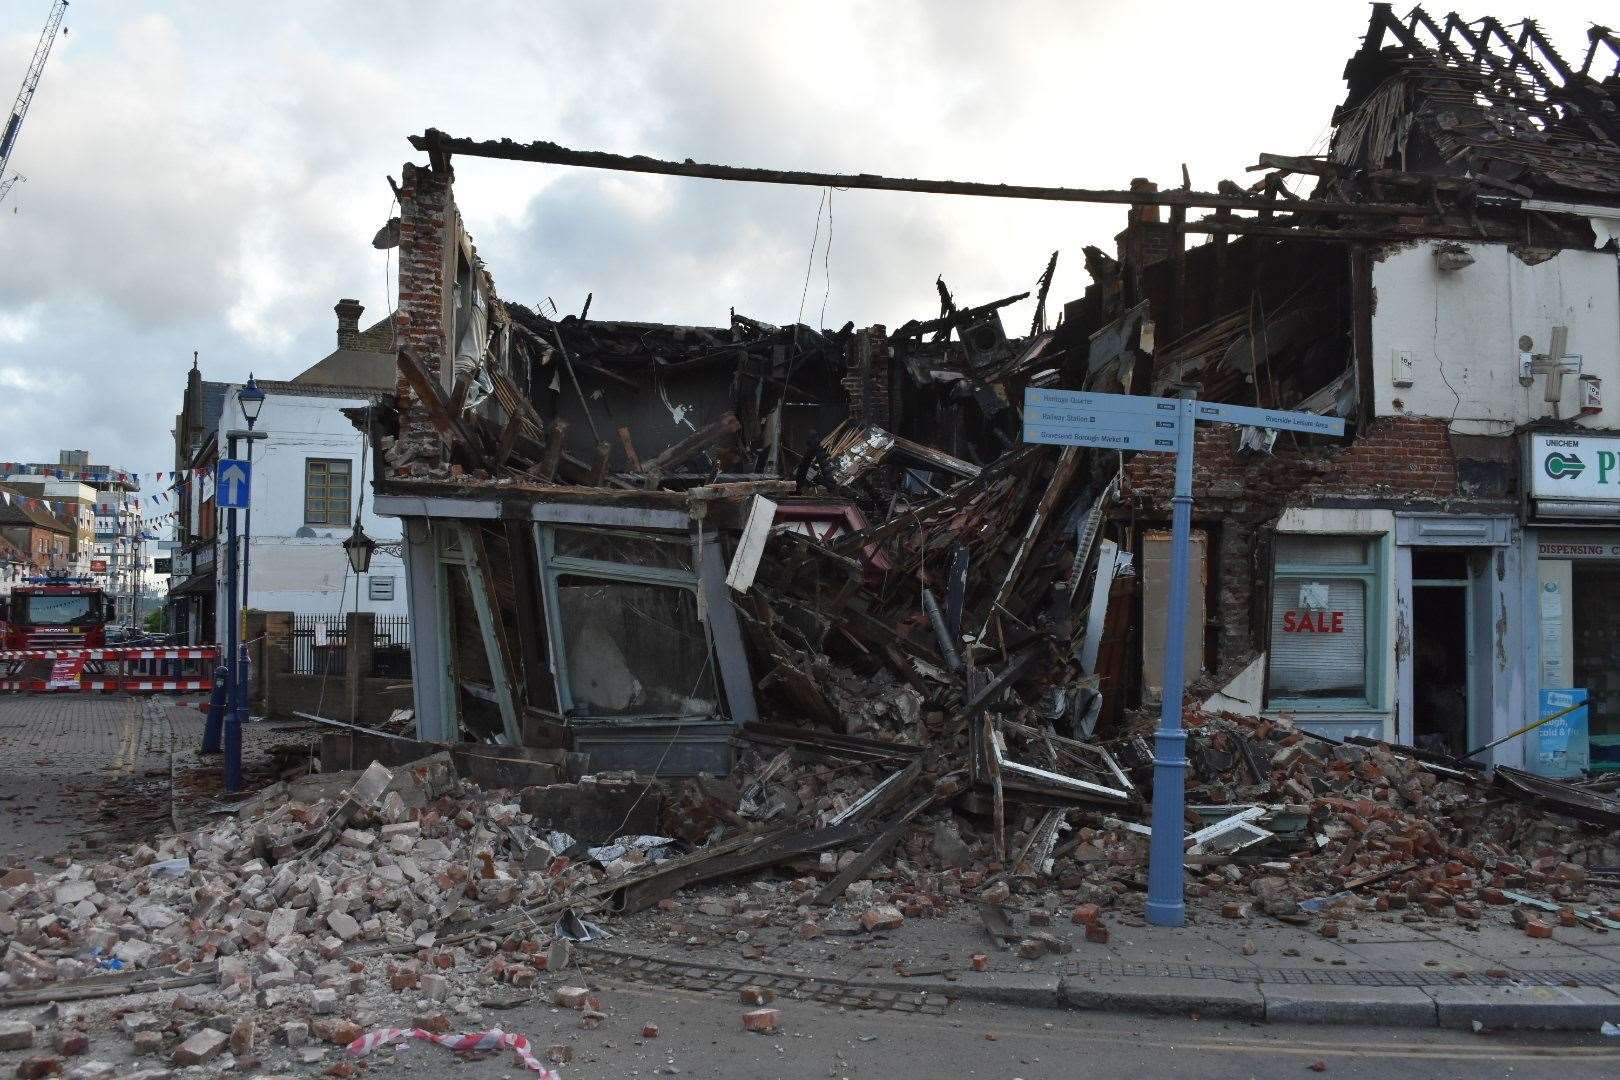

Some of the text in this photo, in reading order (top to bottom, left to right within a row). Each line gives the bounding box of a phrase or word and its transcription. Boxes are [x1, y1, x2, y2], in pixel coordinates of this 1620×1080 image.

[1042, 413, 1088, 423] Railway Station
[1264, 415, 1292, 424] Riverside
[1074, 433, 1099, 442] Borough
[1101, 435, 1121, 443] Market
[1545, 439, 1579, 448] UNICHEM
[1597, 450, 1620, 485] P
[1538, 543, 1603, 555] DISPENSING
[1282, 610, 1344, 633] SALE
